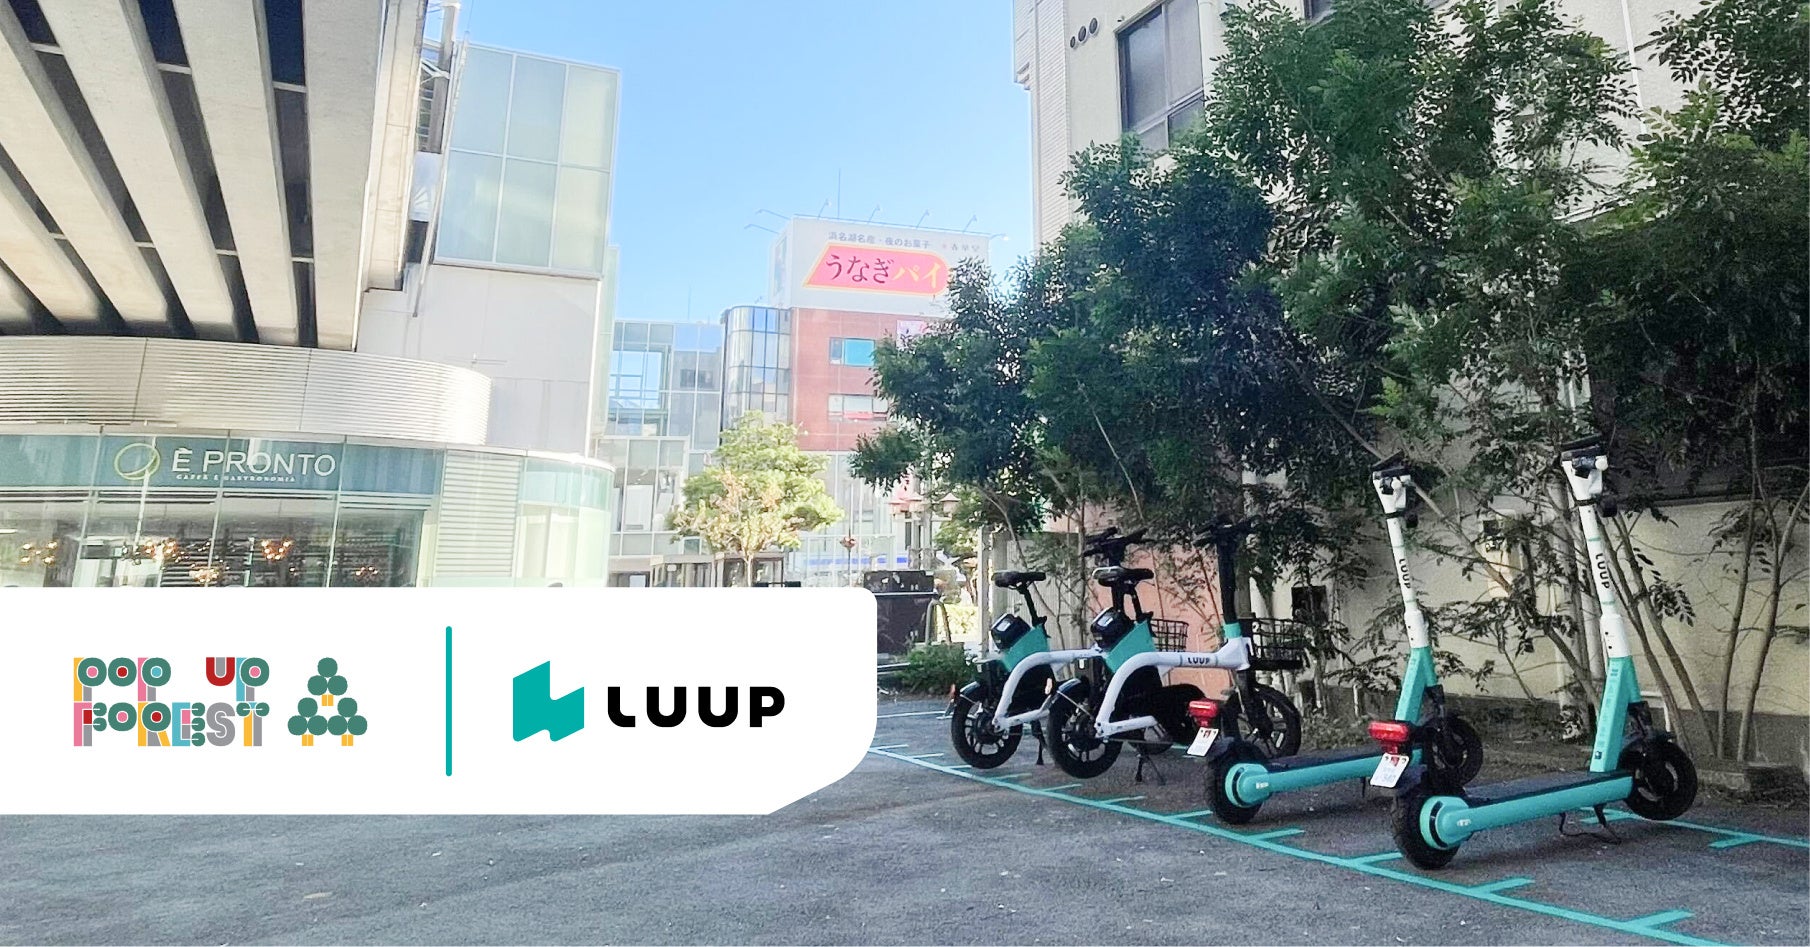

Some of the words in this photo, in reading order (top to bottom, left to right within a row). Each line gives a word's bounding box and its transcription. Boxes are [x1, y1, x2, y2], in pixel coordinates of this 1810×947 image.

[825, 254, 941, 289] うなぎパイ
[202, 450, 336, 477] PRONTO
[1399, 558, 1411, 589] LUUP
[1595, 553, 1610, 589] LUUP
[1187, 656, 1211, 665] LUUP
